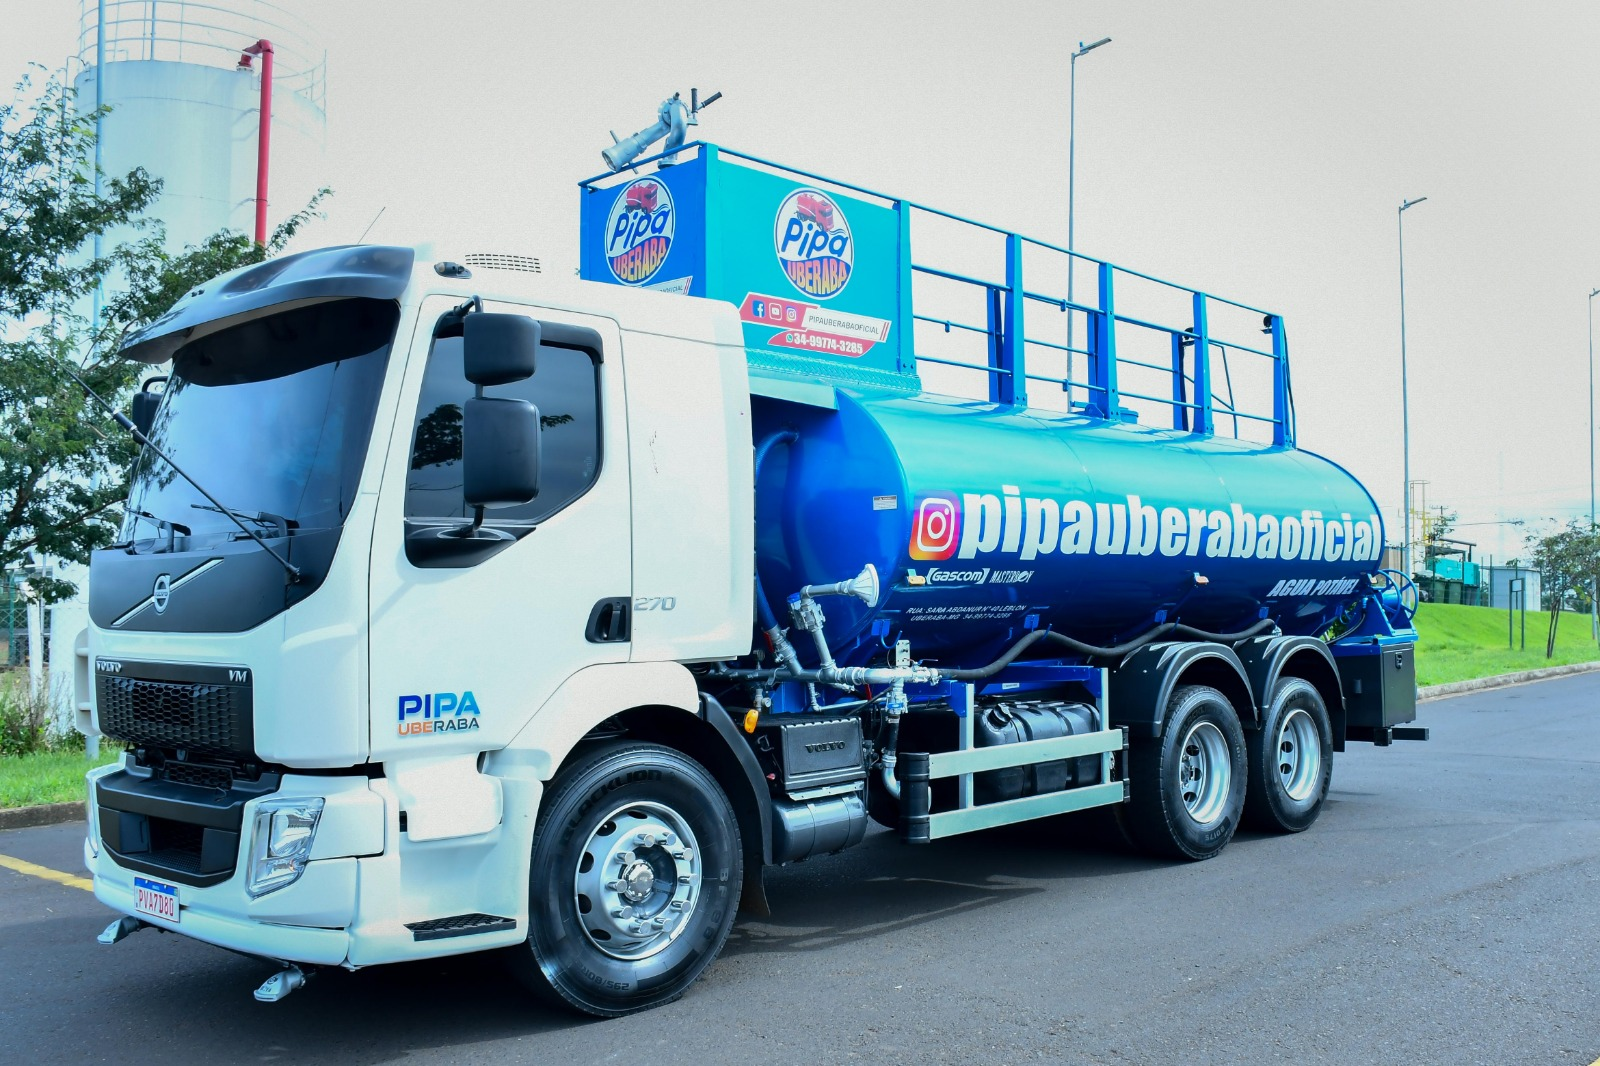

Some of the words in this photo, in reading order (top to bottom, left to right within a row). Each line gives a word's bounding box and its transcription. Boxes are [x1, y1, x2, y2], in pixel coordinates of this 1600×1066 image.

[613, 237, 667, 282] UBERABA
[787, 258, 848, 295] UBERABA
[808, 315, 880, 335] PIPAUBERABAOFICIAL
[793, 333, 864, 355] 34-99774-3285
[957, 484, 1382, 562] pipauberabaoficial
[1265, 579, 1317, 597] AGUA
[1309, 576, 1360, 596] POTÁVEL
[634, 597, 676, 611] 270
[95, 660, 122, 673] VOLVO
[228, 669, 248, 683] VM
[398, 690, 481, 721] PIPA
[397, 717, 480, 736] UBERABA
[805, 740, 846, 753] VOLVO
